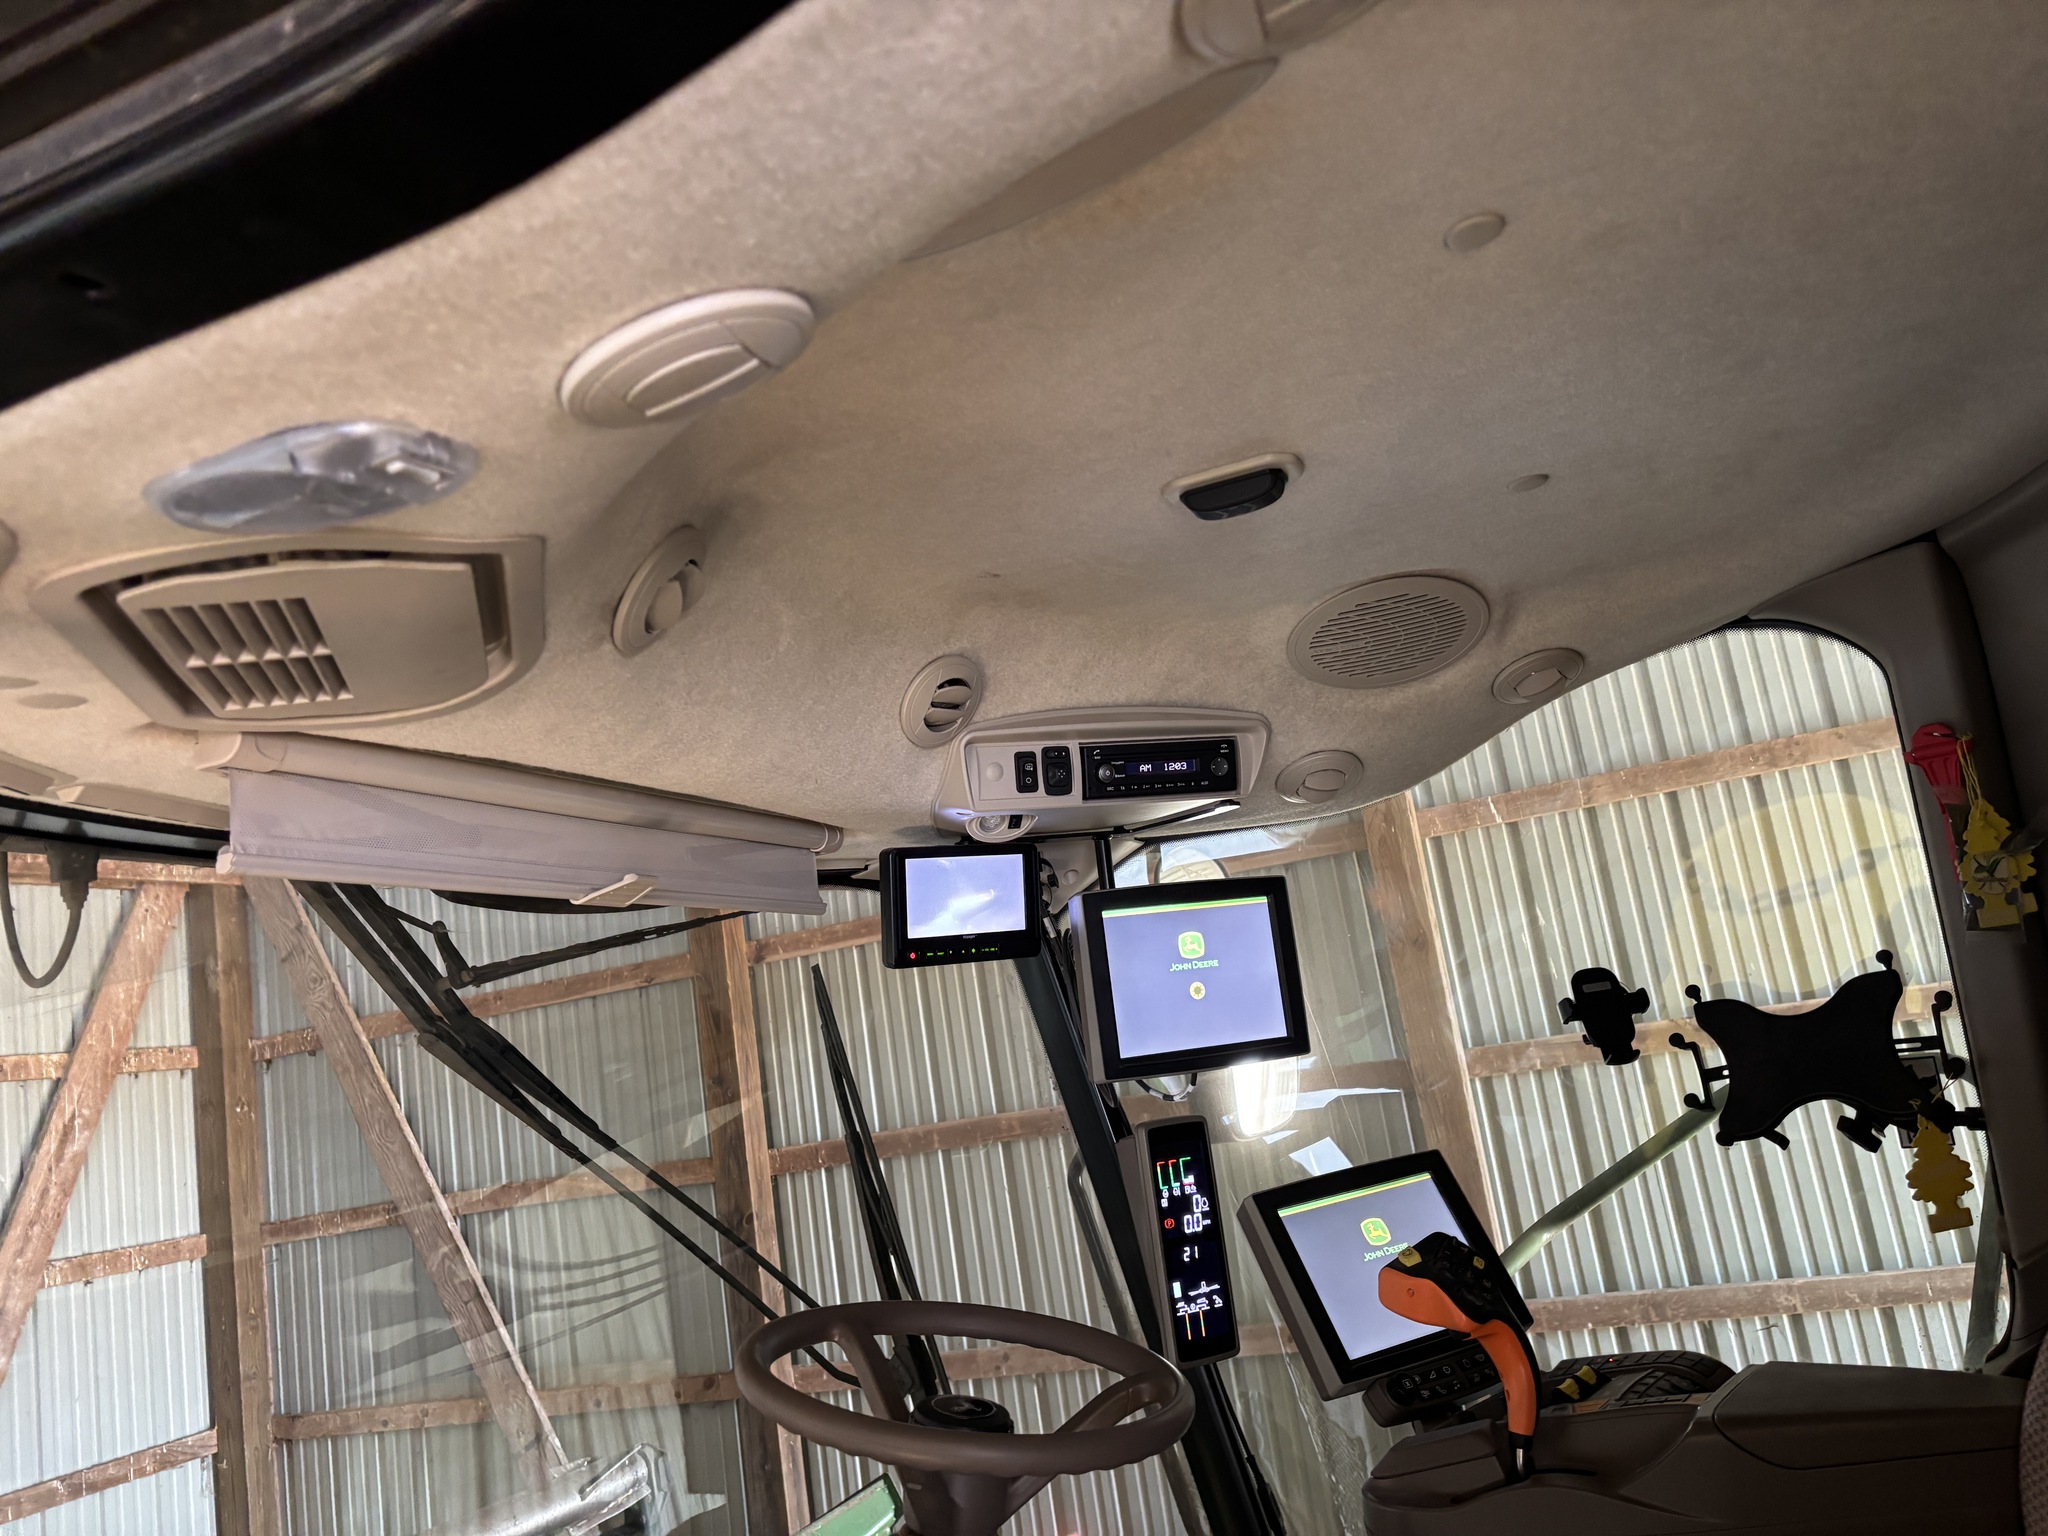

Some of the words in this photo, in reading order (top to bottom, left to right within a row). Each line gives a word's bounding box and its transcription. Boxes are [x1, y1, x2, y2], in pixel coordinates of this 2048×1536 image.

[1139, 763, 1152, 773] AM
[1164, 761, 1187, 771] 1203
[1169, 962, 1192, 972] JOHN
[1192, 959, 1219, 970] DEERE
[1192, 1193, 1202, 1213] 0
[1183, 1212, 1203, 1234] 0.0
[1183, 1245, 1199, 1262] 21
[1363, 1249, 1385, 1262] JOHN
